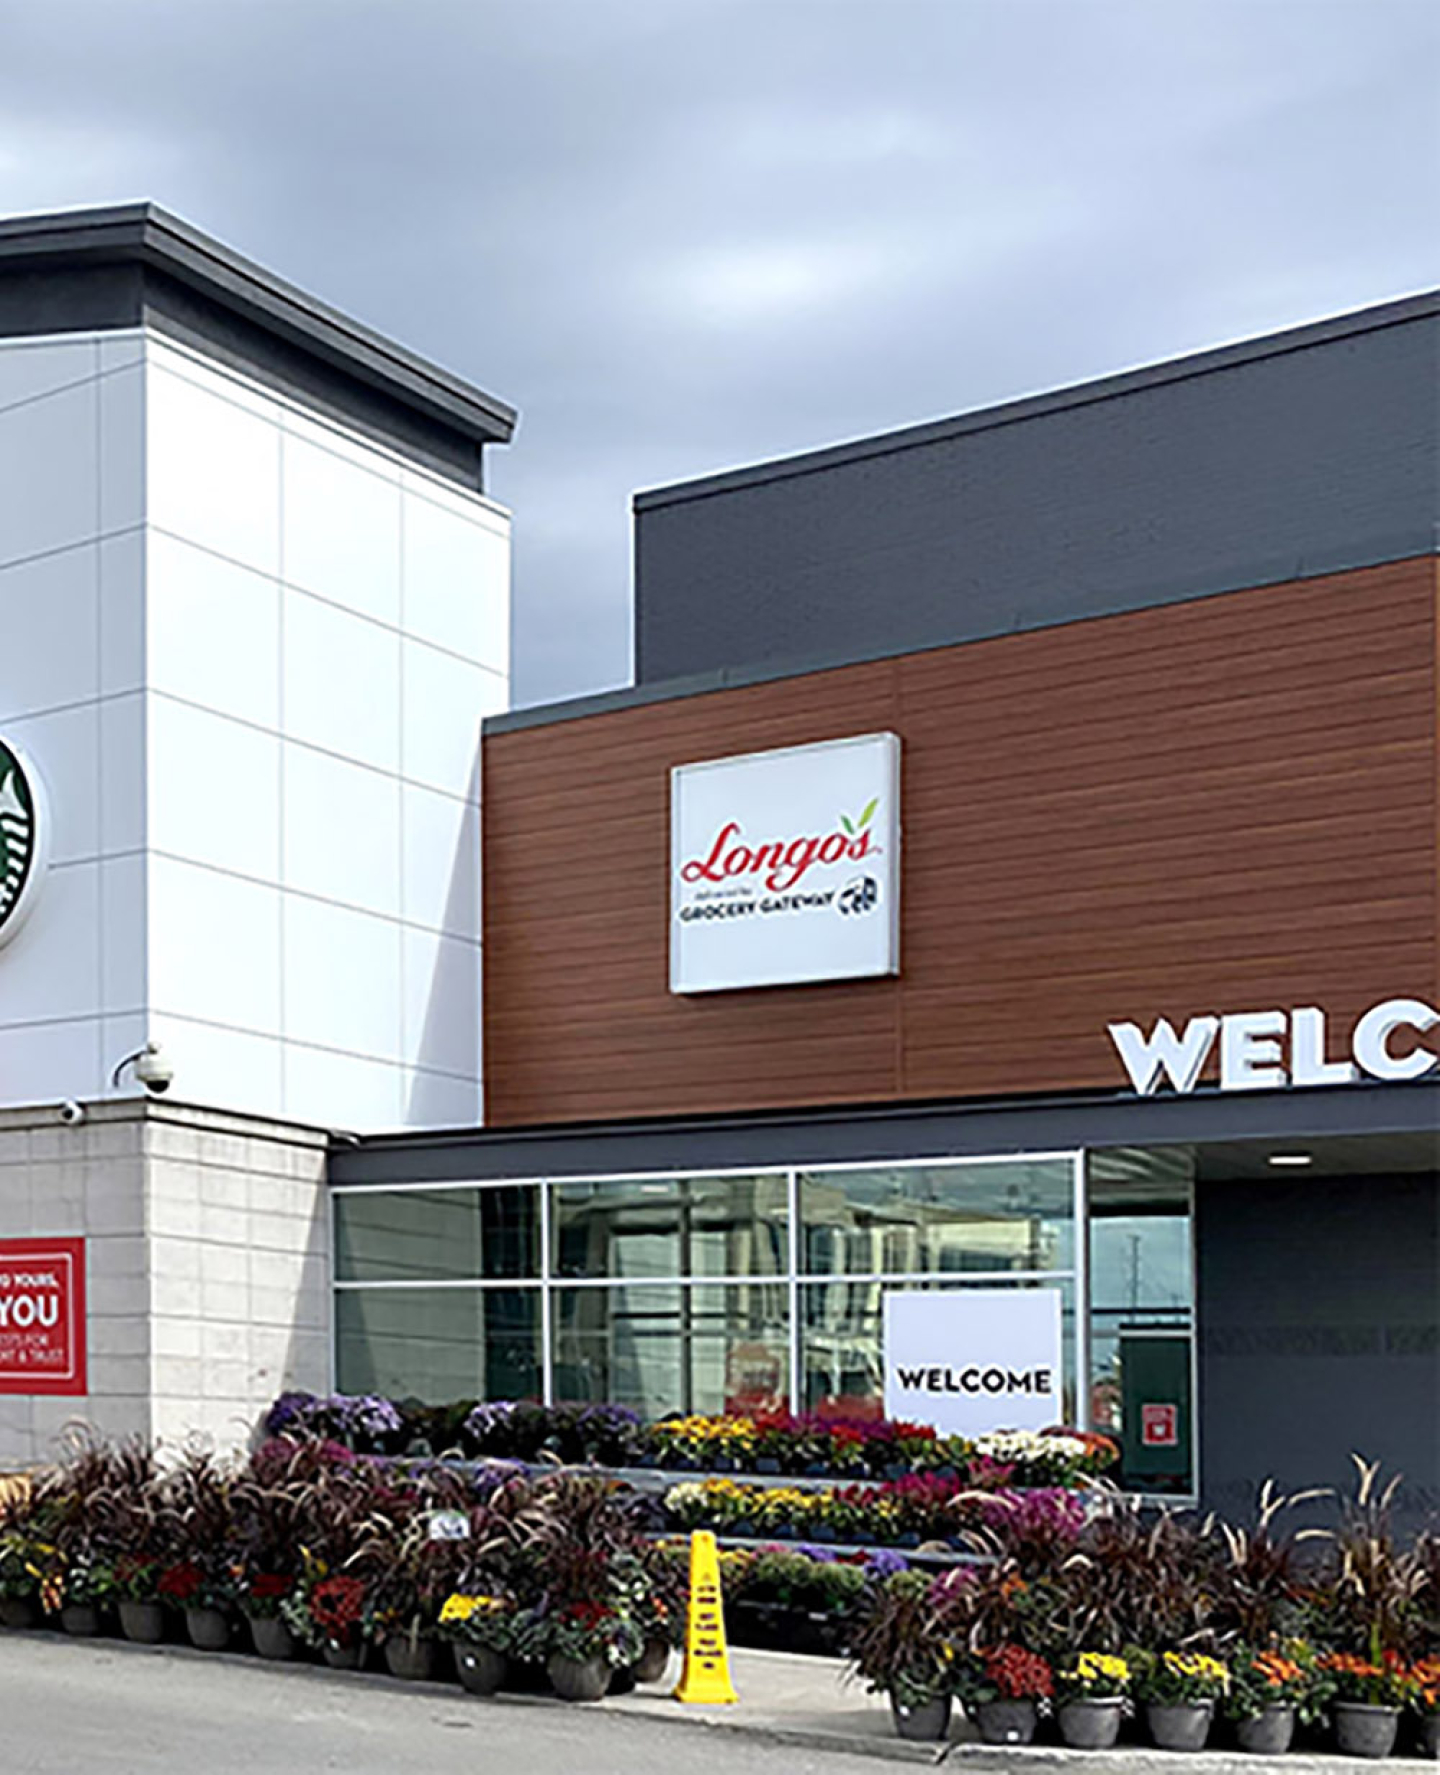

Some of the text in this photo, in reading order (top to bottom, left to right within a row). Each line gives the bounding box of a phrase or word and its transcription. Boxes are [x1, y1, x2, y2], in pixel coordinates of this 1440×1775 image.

[679, 901, 756, 922] GROCERY
[760, 890, 835, 913] GATEWAY
[897, 1367, 1052, 1394] WELCOME
